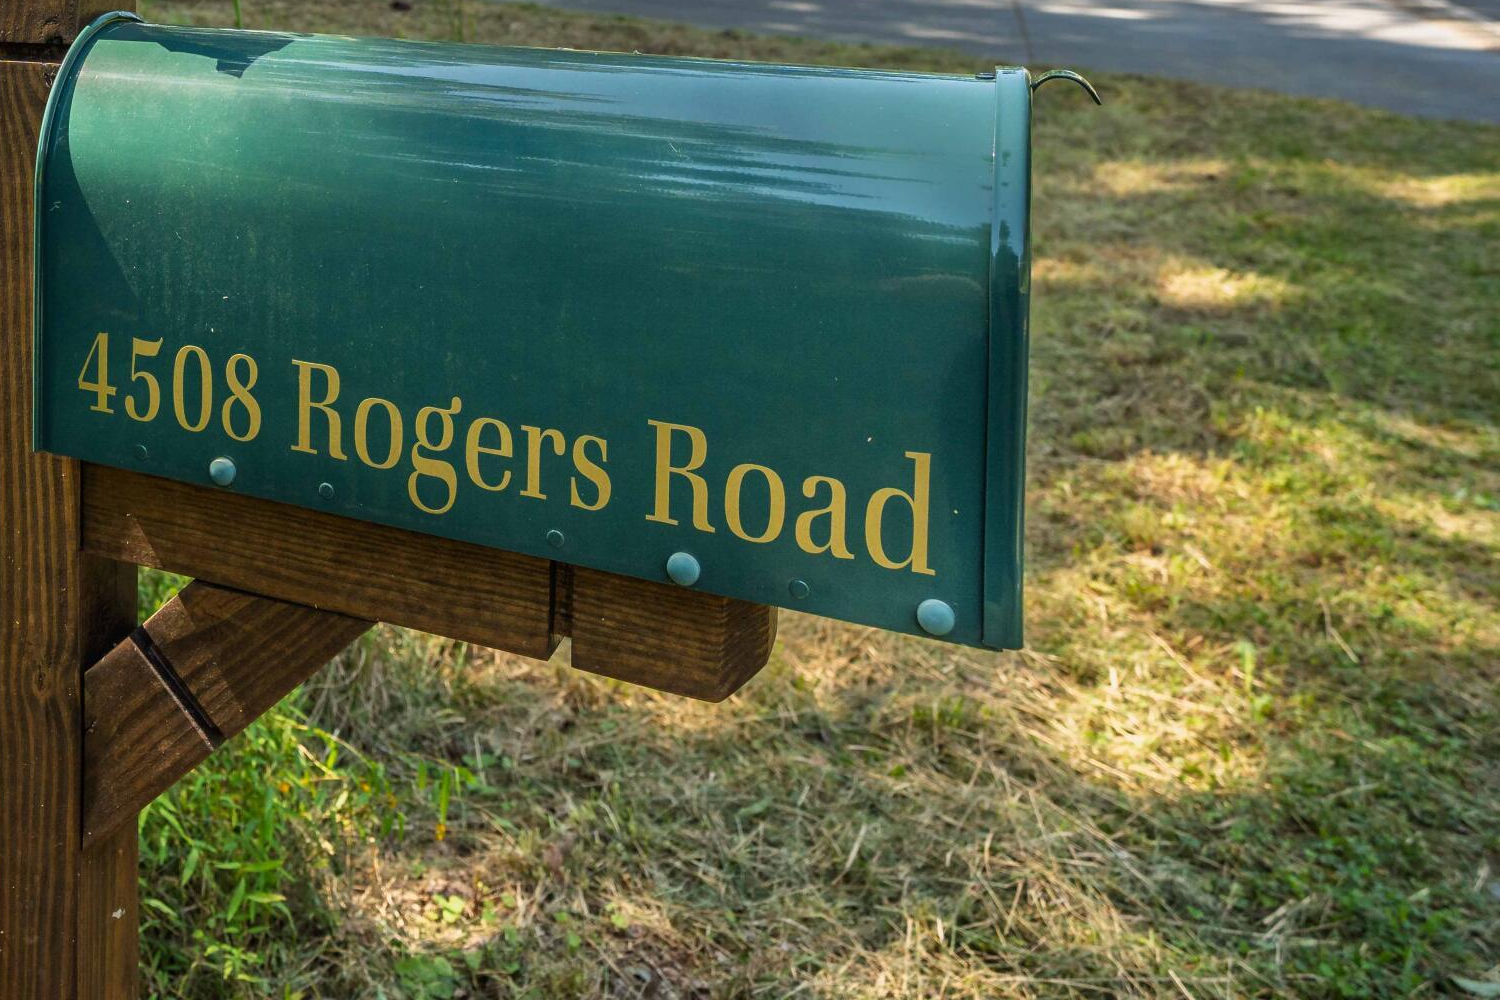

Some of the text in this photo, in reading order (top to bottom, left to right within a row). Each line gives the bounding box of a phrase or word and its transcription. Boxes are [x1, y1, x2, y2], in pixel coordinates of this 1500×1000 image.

[77, 332, 936, 576] 4508 Rogers Road
